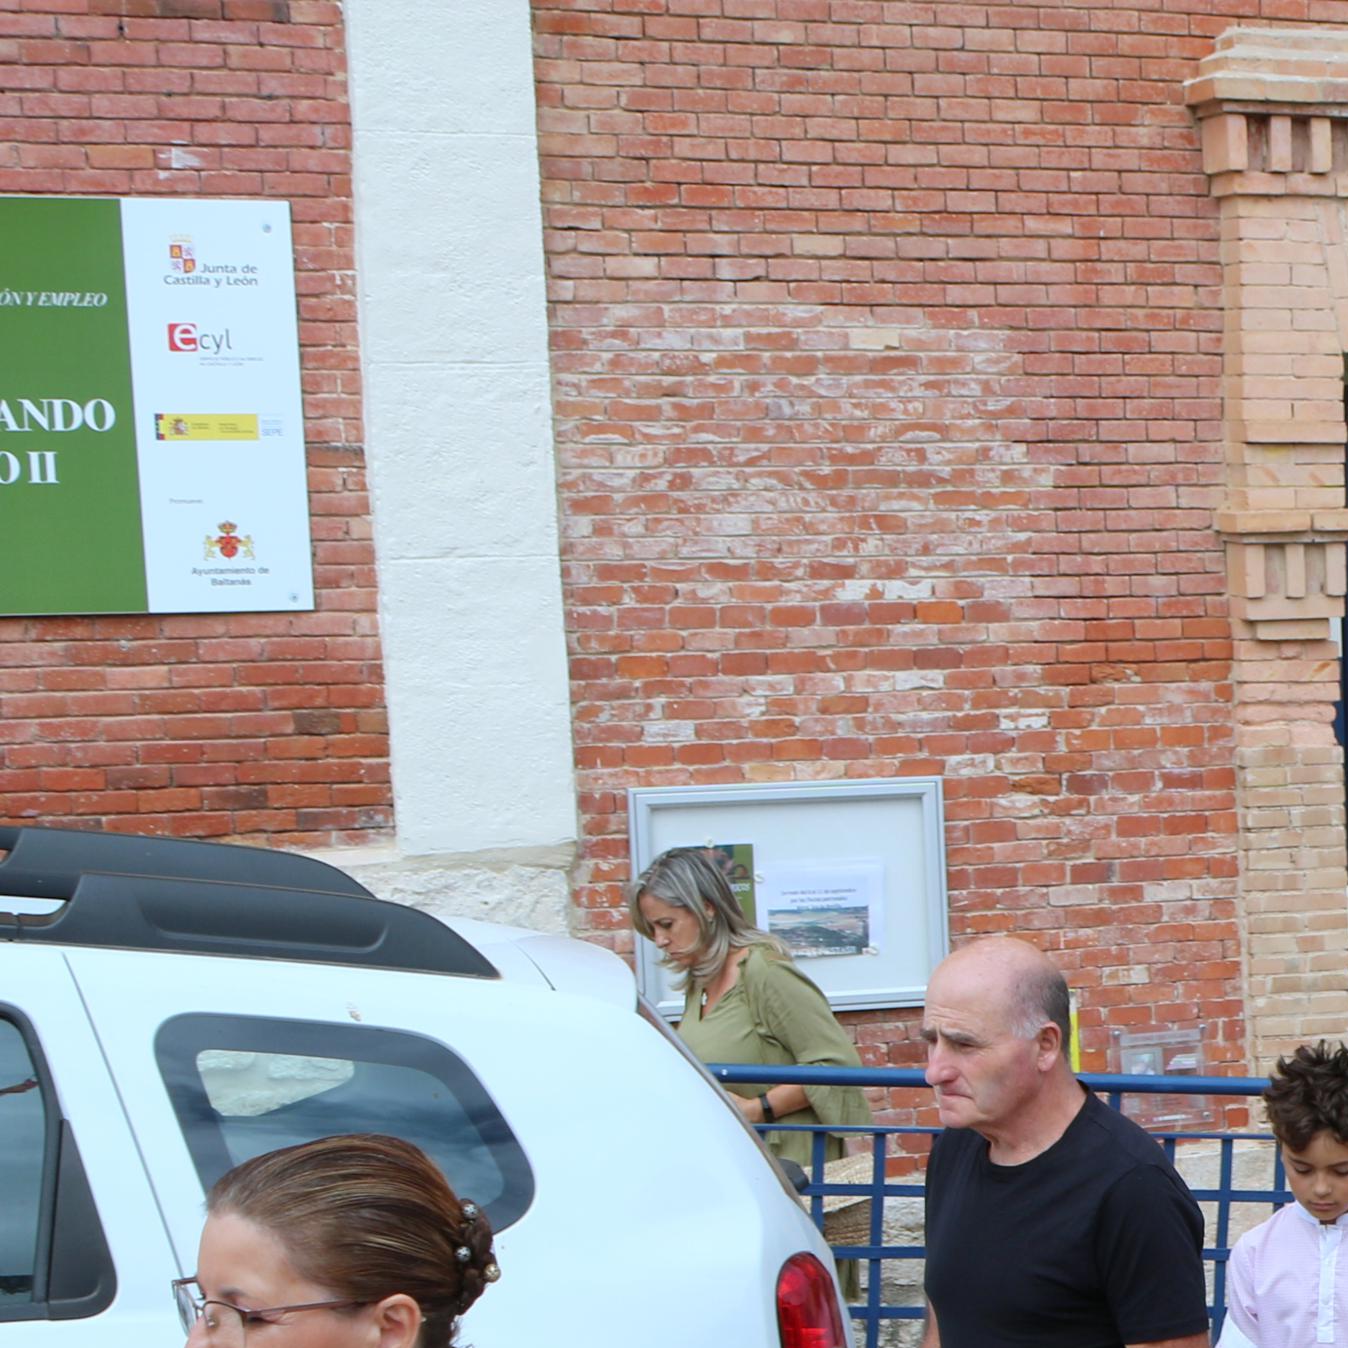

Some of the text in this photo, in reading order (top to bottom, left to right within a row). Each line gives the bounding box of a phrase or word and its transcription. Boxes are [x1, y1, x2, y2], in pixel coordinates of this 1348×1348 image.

[200, 263, 258, 274] Junta de
[163, 275, 259, 289] Castilla y León
[25, 291, 39, 307] Y
[38, 291, 108, 308] EMPLEO
[173, 322, 232, 356] ecyl
[0, 398, 116, 433] ANDO
[26, 451, 60, 485] II
